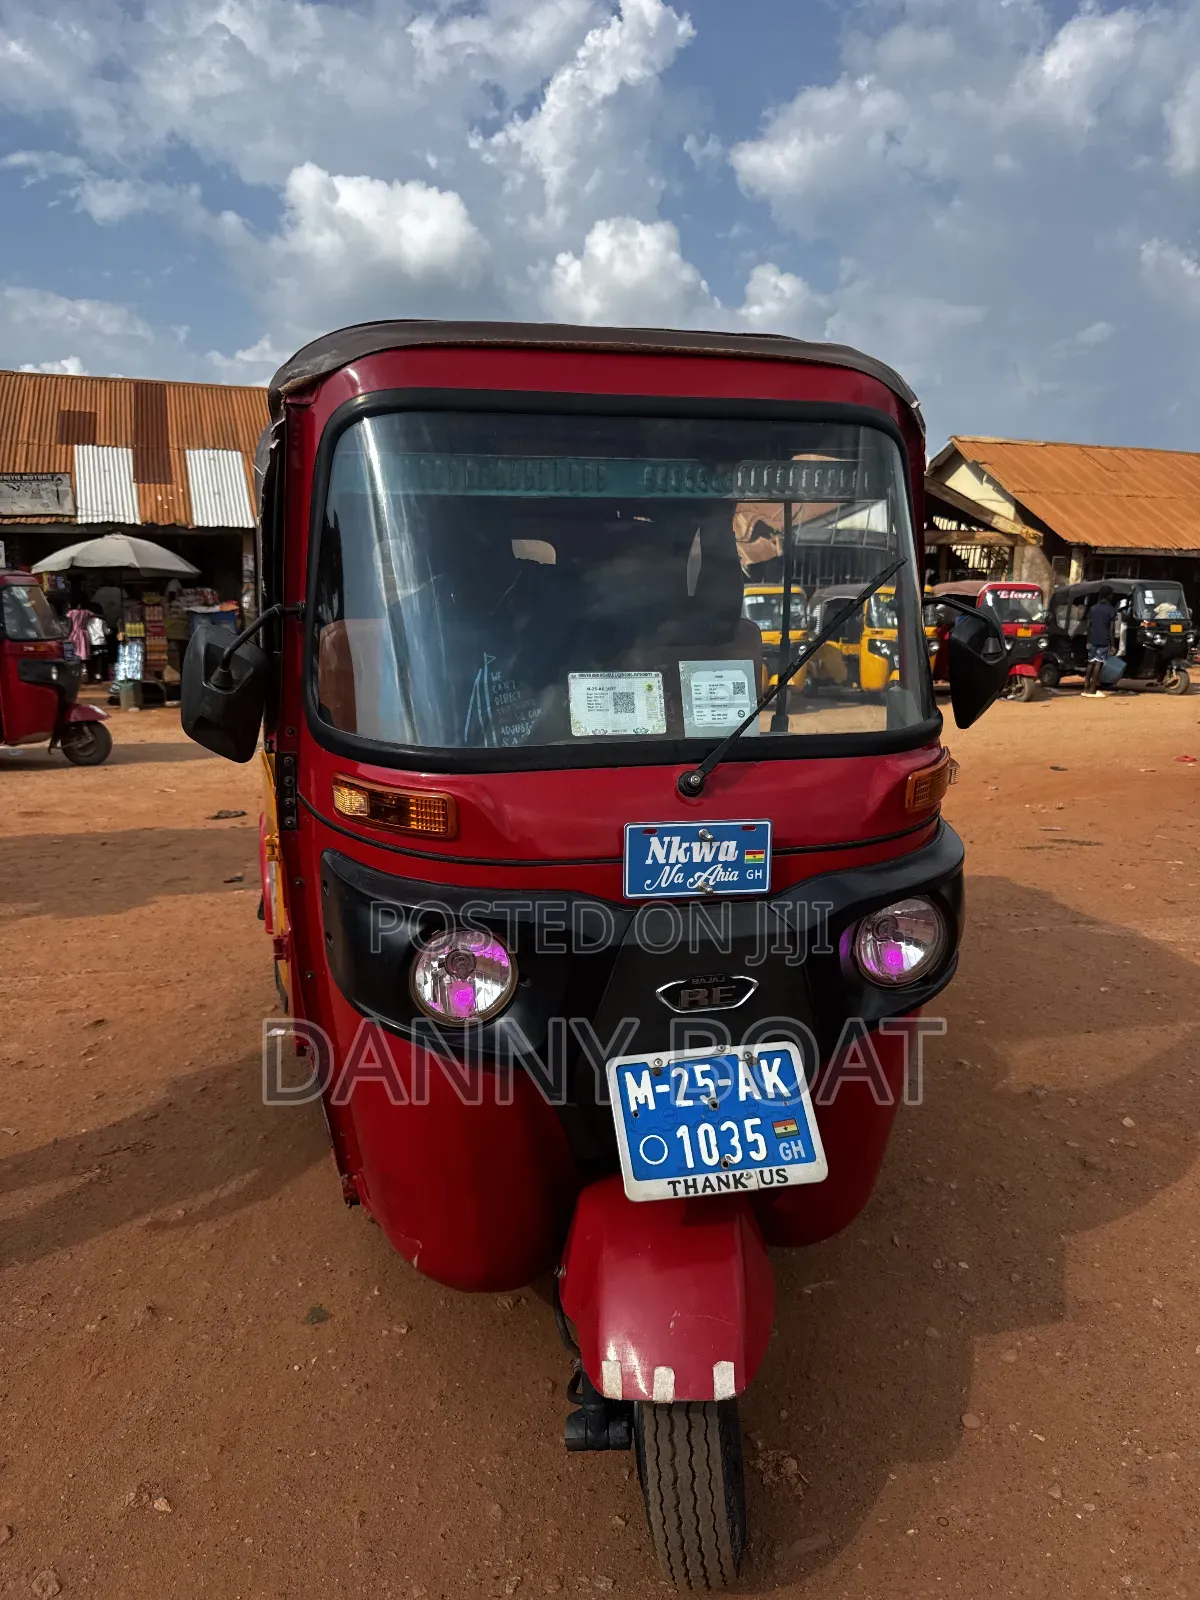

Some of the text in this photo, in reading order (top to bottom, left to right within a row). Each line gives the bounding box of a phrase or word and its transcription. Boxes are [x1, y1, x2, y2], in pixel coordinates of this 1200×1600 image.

[645, 836, 739, 864] Nkwa
[644, 864, 740, 891] Na Ahia
[746, 869, 763, 880] GH
[691, 976, 726, 985] BAJAJ
[679, 985, 737, 1009] RE
[624, 1057, 791, 1112] M-25-AK
[676, 1118, 767, 1168] 1035
[778, 1140, 806, 1160] GH
[667, 1168, 789, 1197] THANK US
